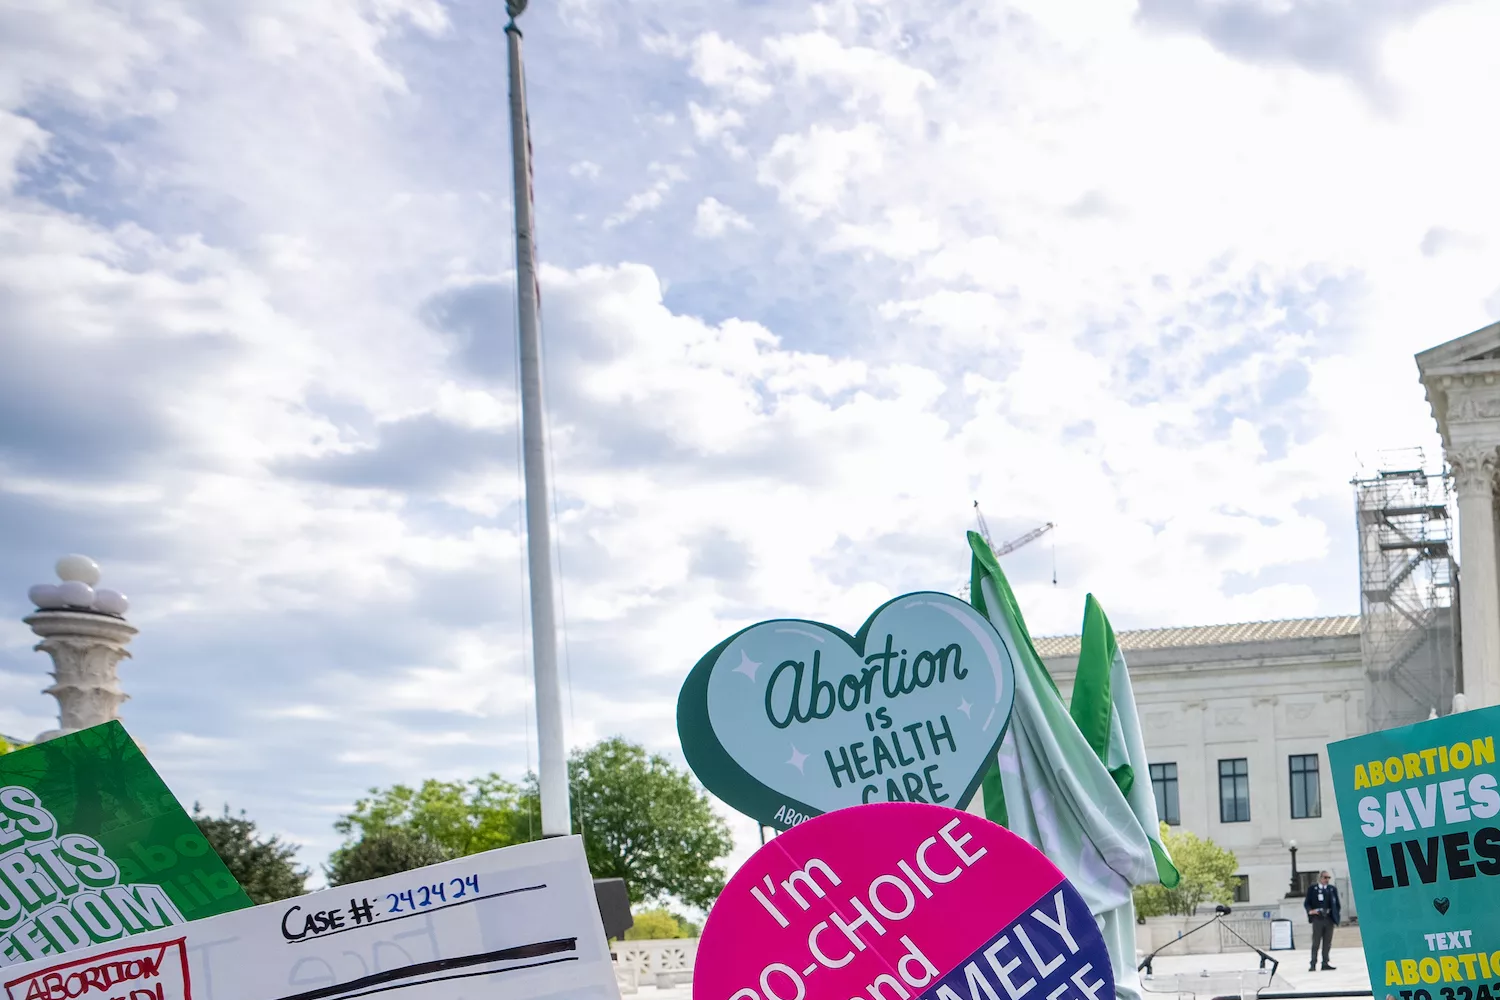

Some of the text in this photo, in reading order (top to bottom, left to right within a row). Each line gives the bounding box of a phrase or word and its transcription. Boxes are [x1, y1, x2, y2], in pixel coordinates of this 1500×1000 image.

[764, 633, 969, 729] Abortion
[824, 714, 957, 789] HEALTH
[1353, 735, 1496, 790] ABORTION
[862, 764, 950, 804] CARE
[1357, 773, 1500, 838] SAVES
[750, 855, 842, 928] I'm
[281, 905, 345, 941] CASE
[1424, 929, 1473, 952] TEXT
